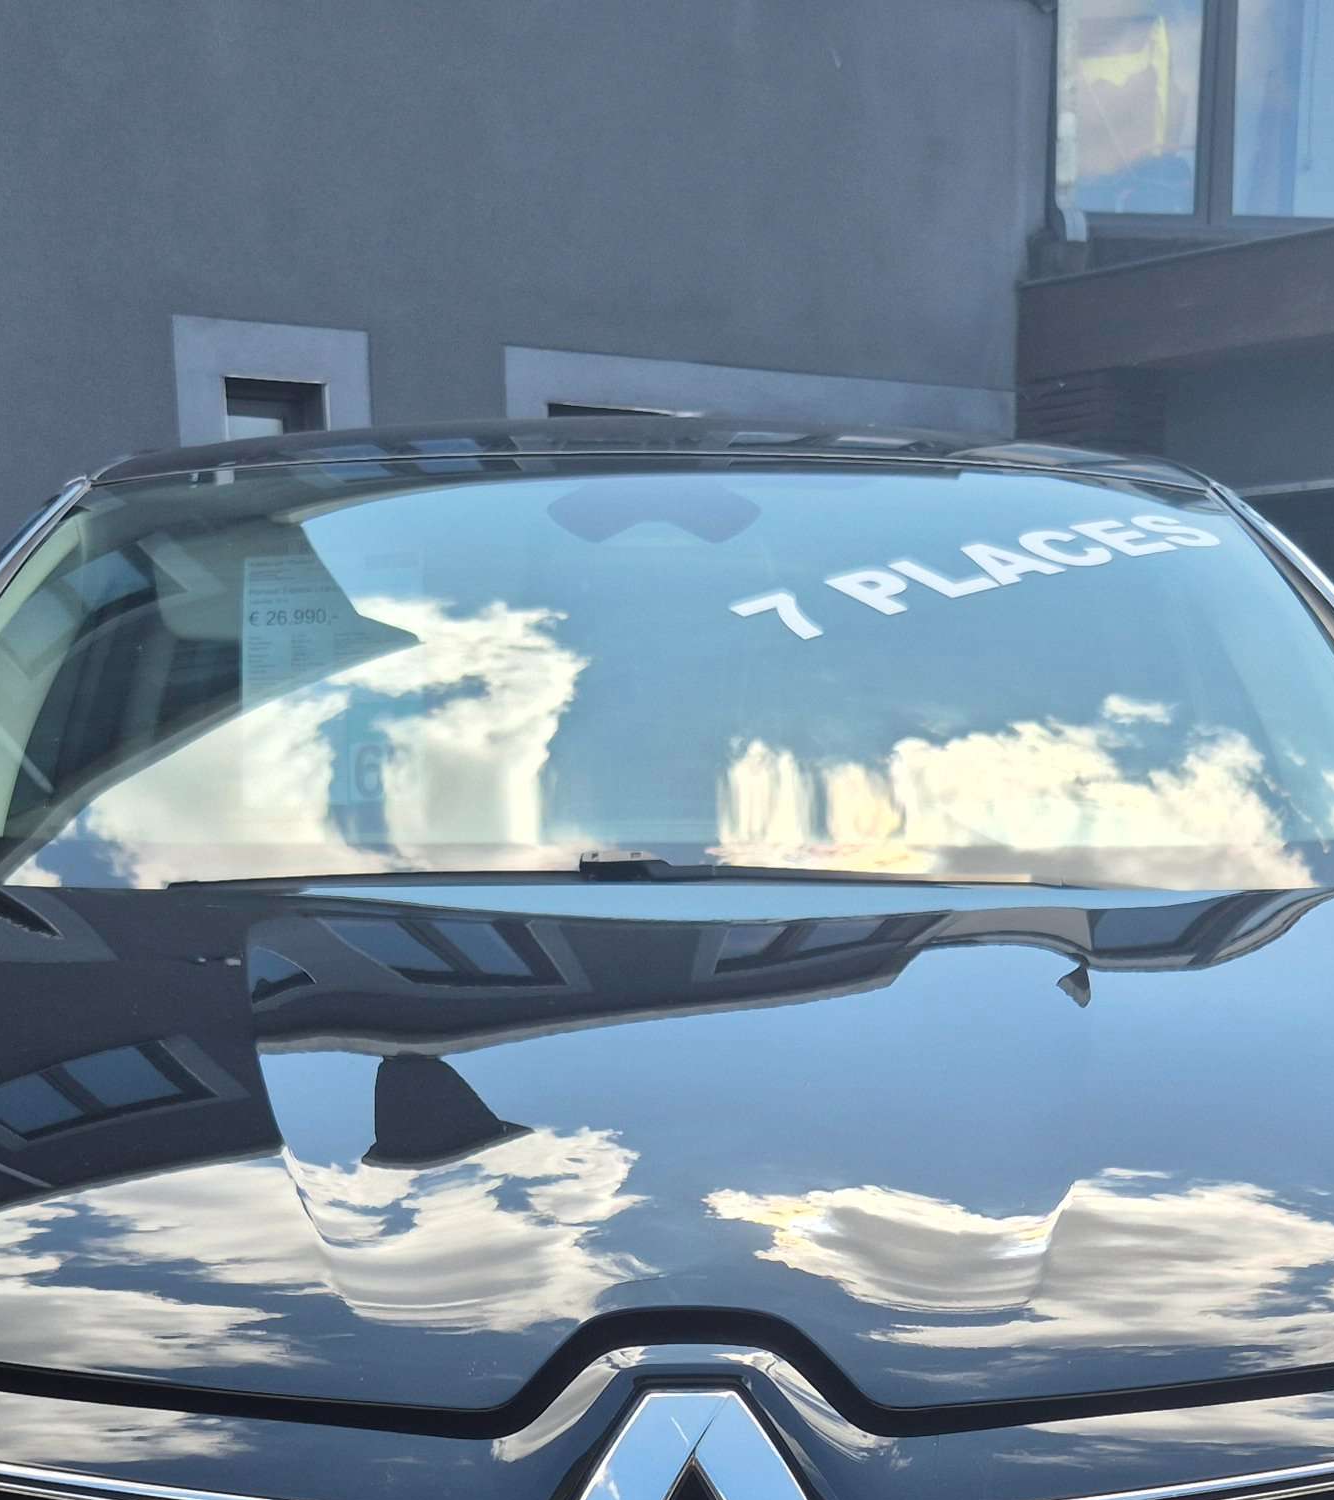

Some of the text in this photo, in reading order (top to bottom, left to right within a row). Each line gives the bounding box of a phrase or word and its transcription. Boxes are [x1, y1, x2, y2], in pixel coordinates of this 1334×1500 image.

[729, 515, 1221, 640] 7 PLACES
[249, 609, 260, 627] €
